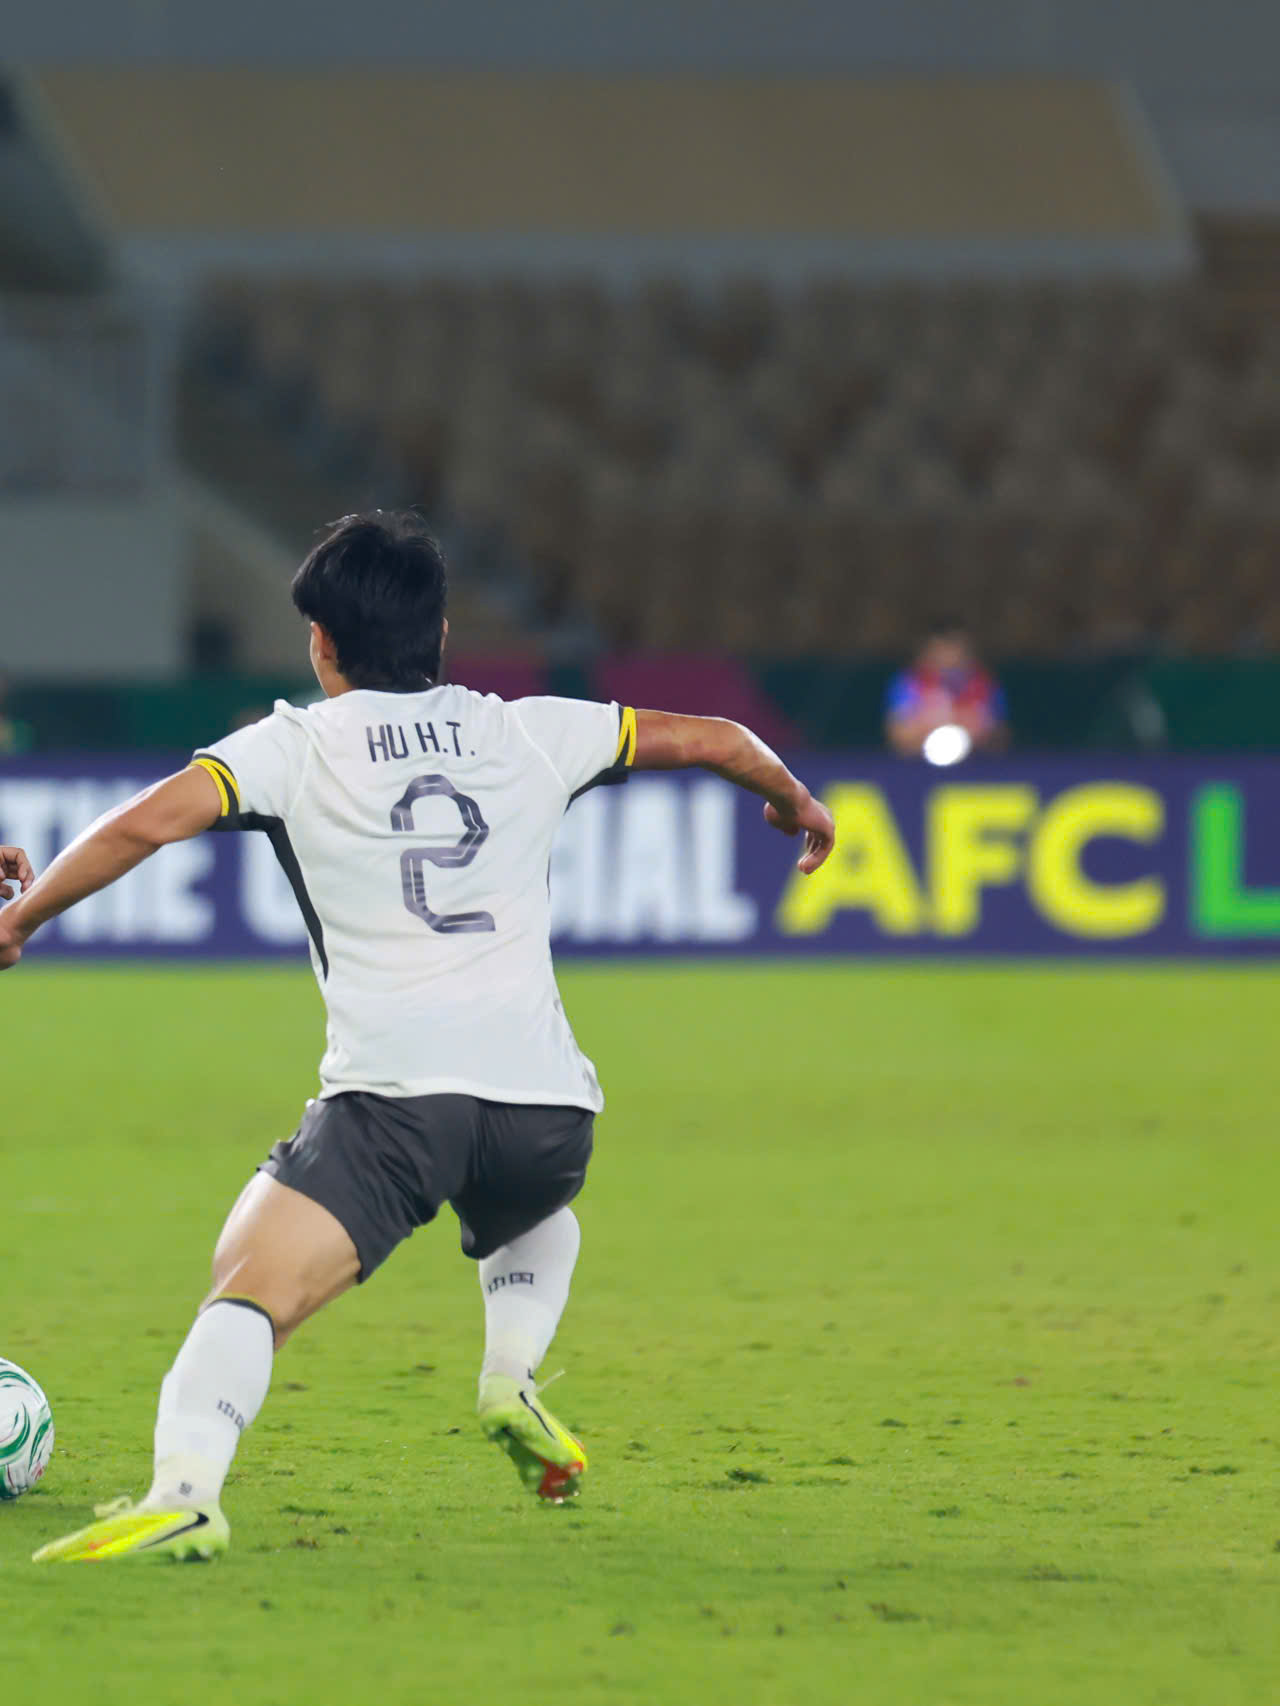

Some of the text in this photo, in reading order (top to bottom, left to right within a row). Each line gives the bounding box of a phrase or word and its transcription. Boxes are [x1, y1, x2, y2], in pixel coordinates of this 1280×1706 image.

[366, 721, 476, 763] HU H.T.
[390, 774, 496, 934] 2
[776, 780, 1166, 938] AFC
